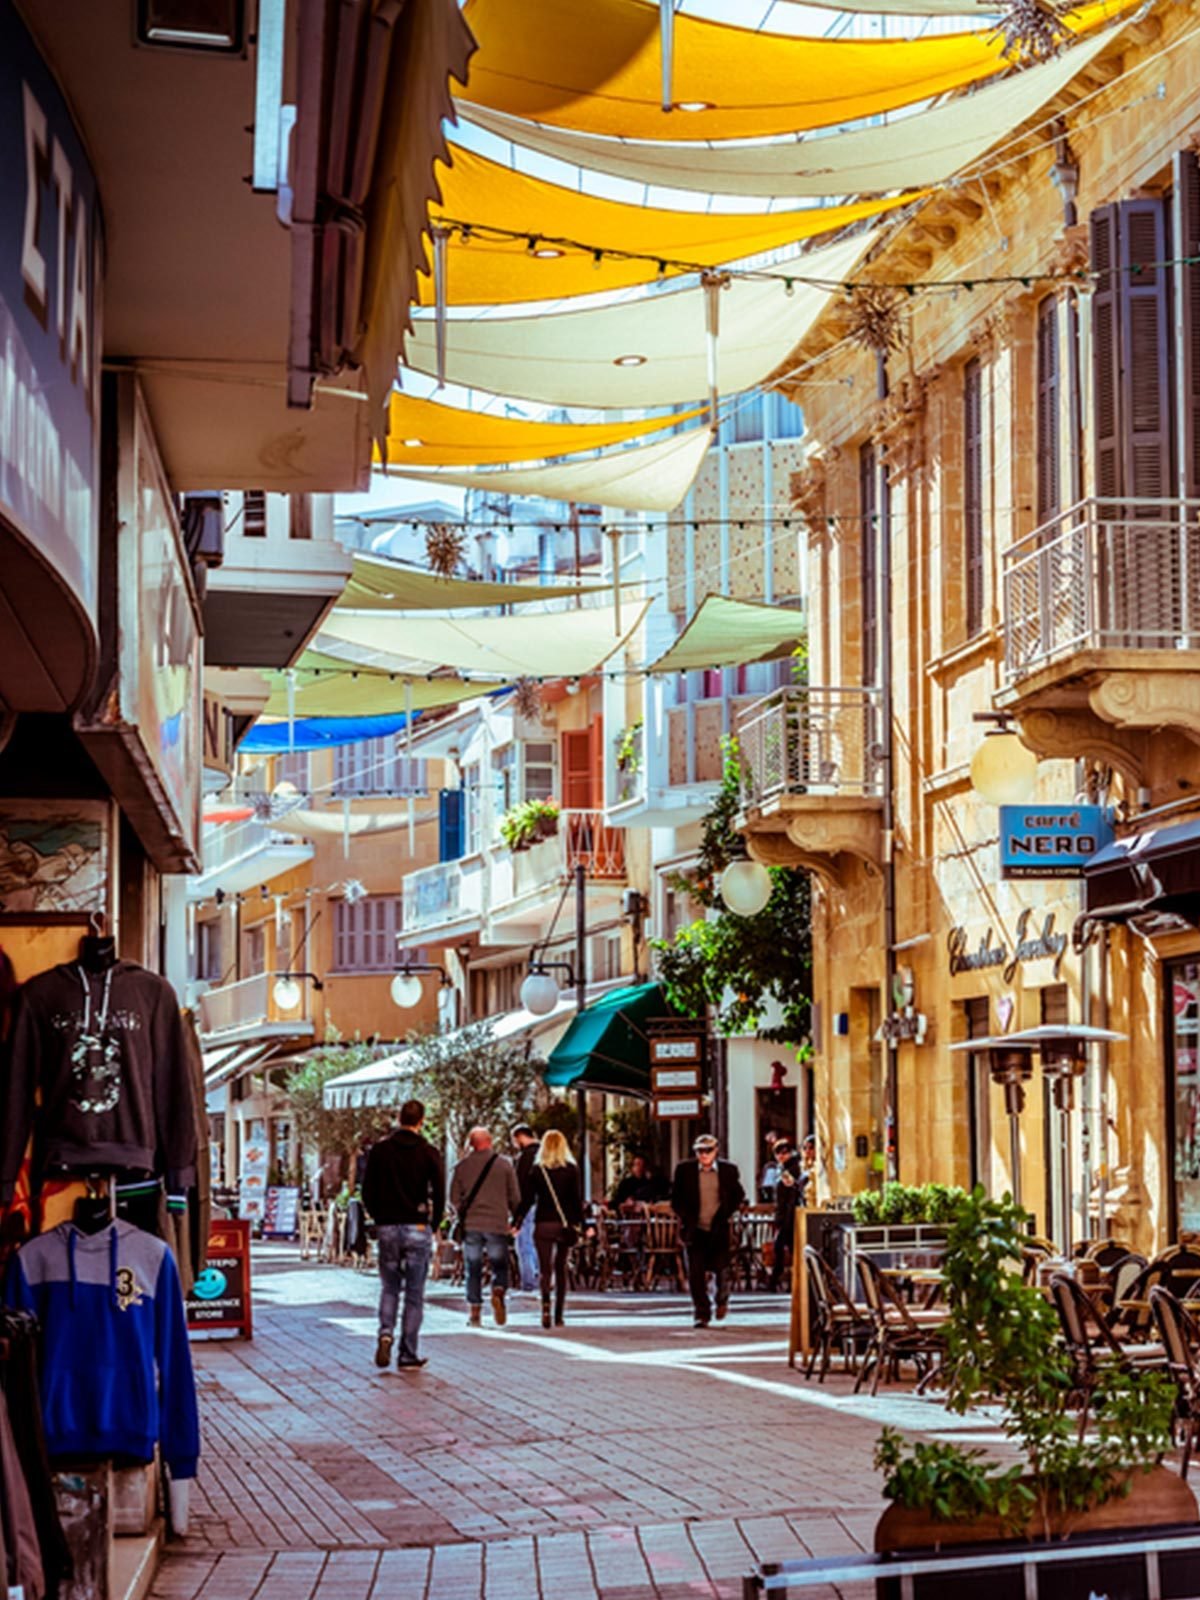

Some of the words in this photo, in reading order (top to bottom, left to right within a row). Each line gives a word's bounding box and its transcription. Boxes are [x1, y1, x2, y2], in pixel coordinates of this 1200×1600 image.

[1009, 835, 1096, 855] NERO
[115, 1268, 134, 1297] 3
[195, 1310, 224, 1319] STORE
